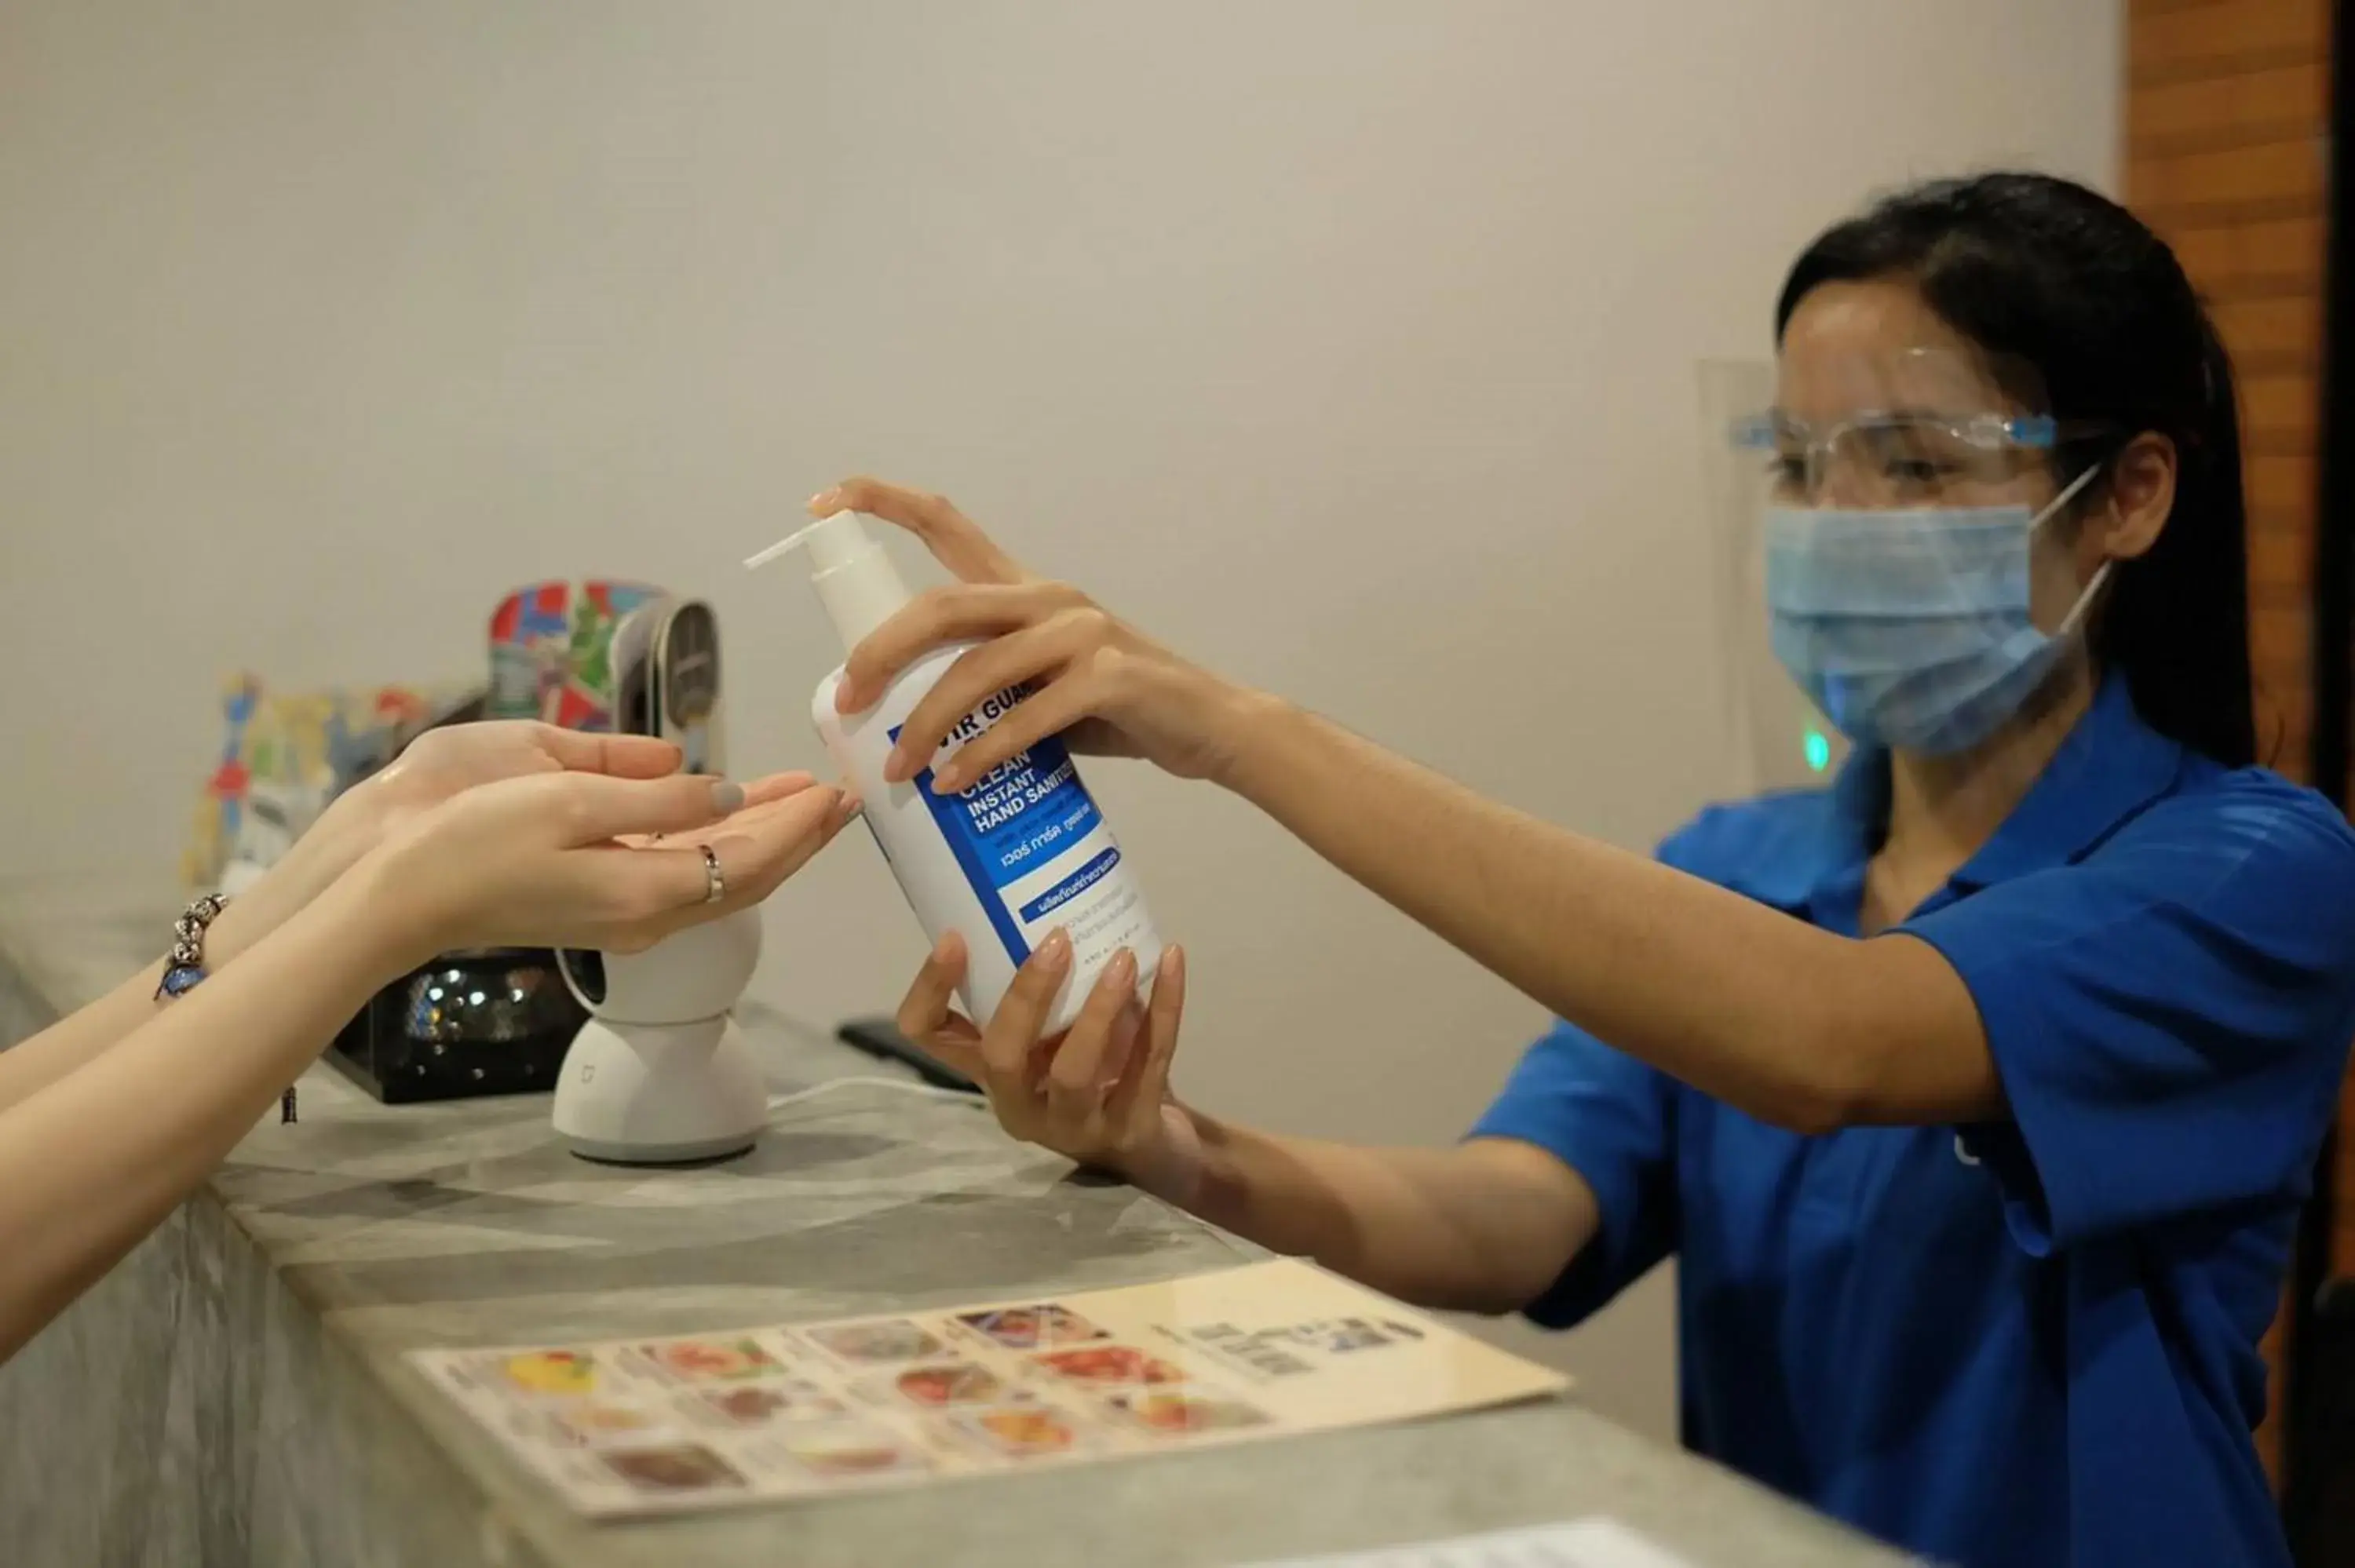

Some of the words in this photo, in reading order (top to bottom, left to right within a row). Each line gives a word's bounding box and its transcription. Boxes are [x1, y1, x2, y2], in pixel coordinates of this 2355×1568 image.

[959, 750, 1031, 799] CLEAN
[967, 768, 1036, 818] INSTANT
[974, 797, 1024, 833] HAND
